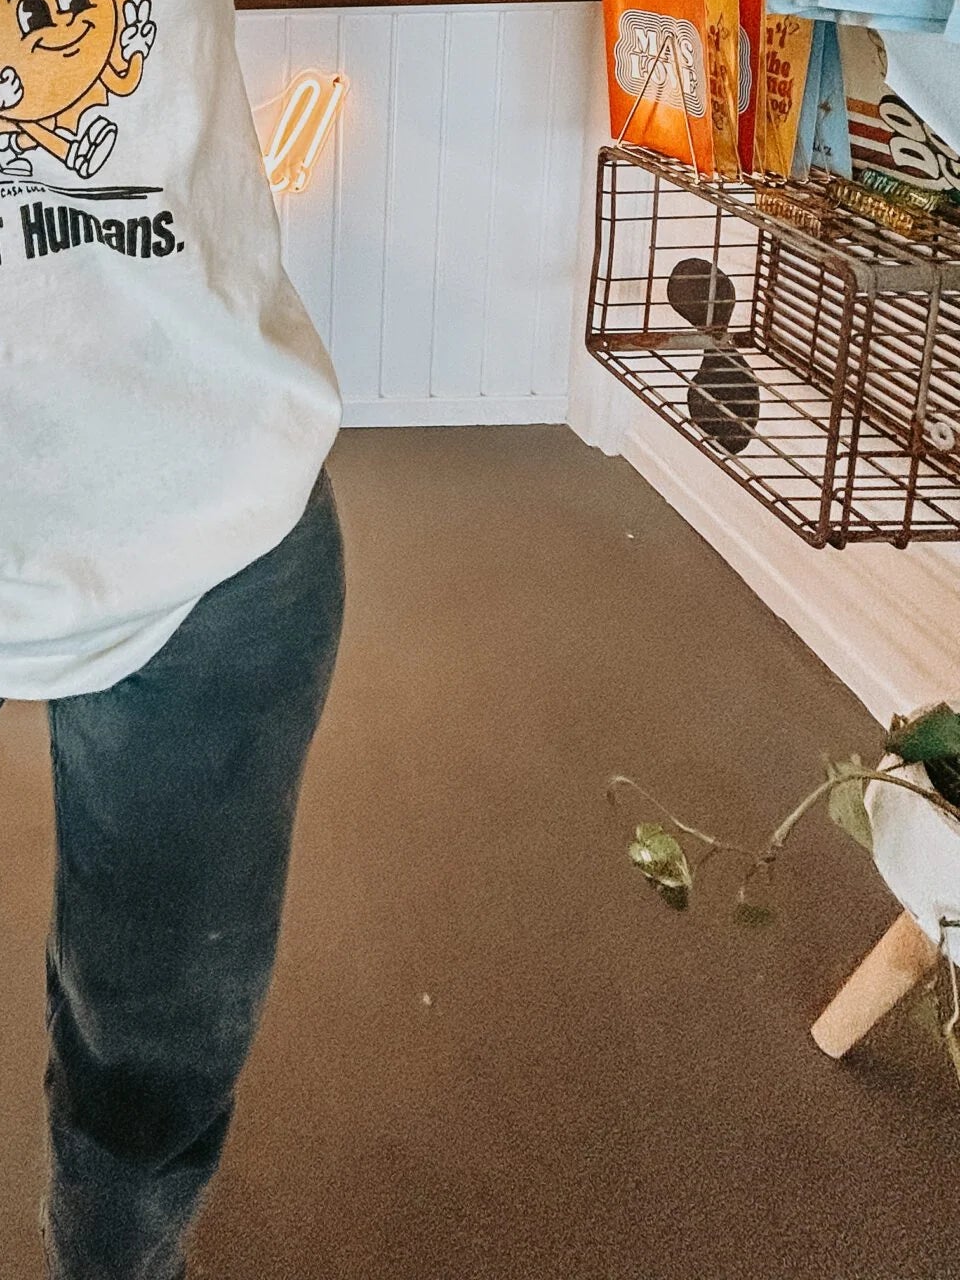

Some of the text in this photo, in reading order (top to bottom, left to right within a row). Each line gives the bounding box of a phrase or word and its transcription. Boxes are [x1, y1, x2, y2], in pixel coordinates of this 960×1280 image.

[634, 28, 694, 67] MAS
[629, 52, 698, 97] LOVE
[0, 185, 23, 198] CASA
[19, 202, 185, 260] Humans.
